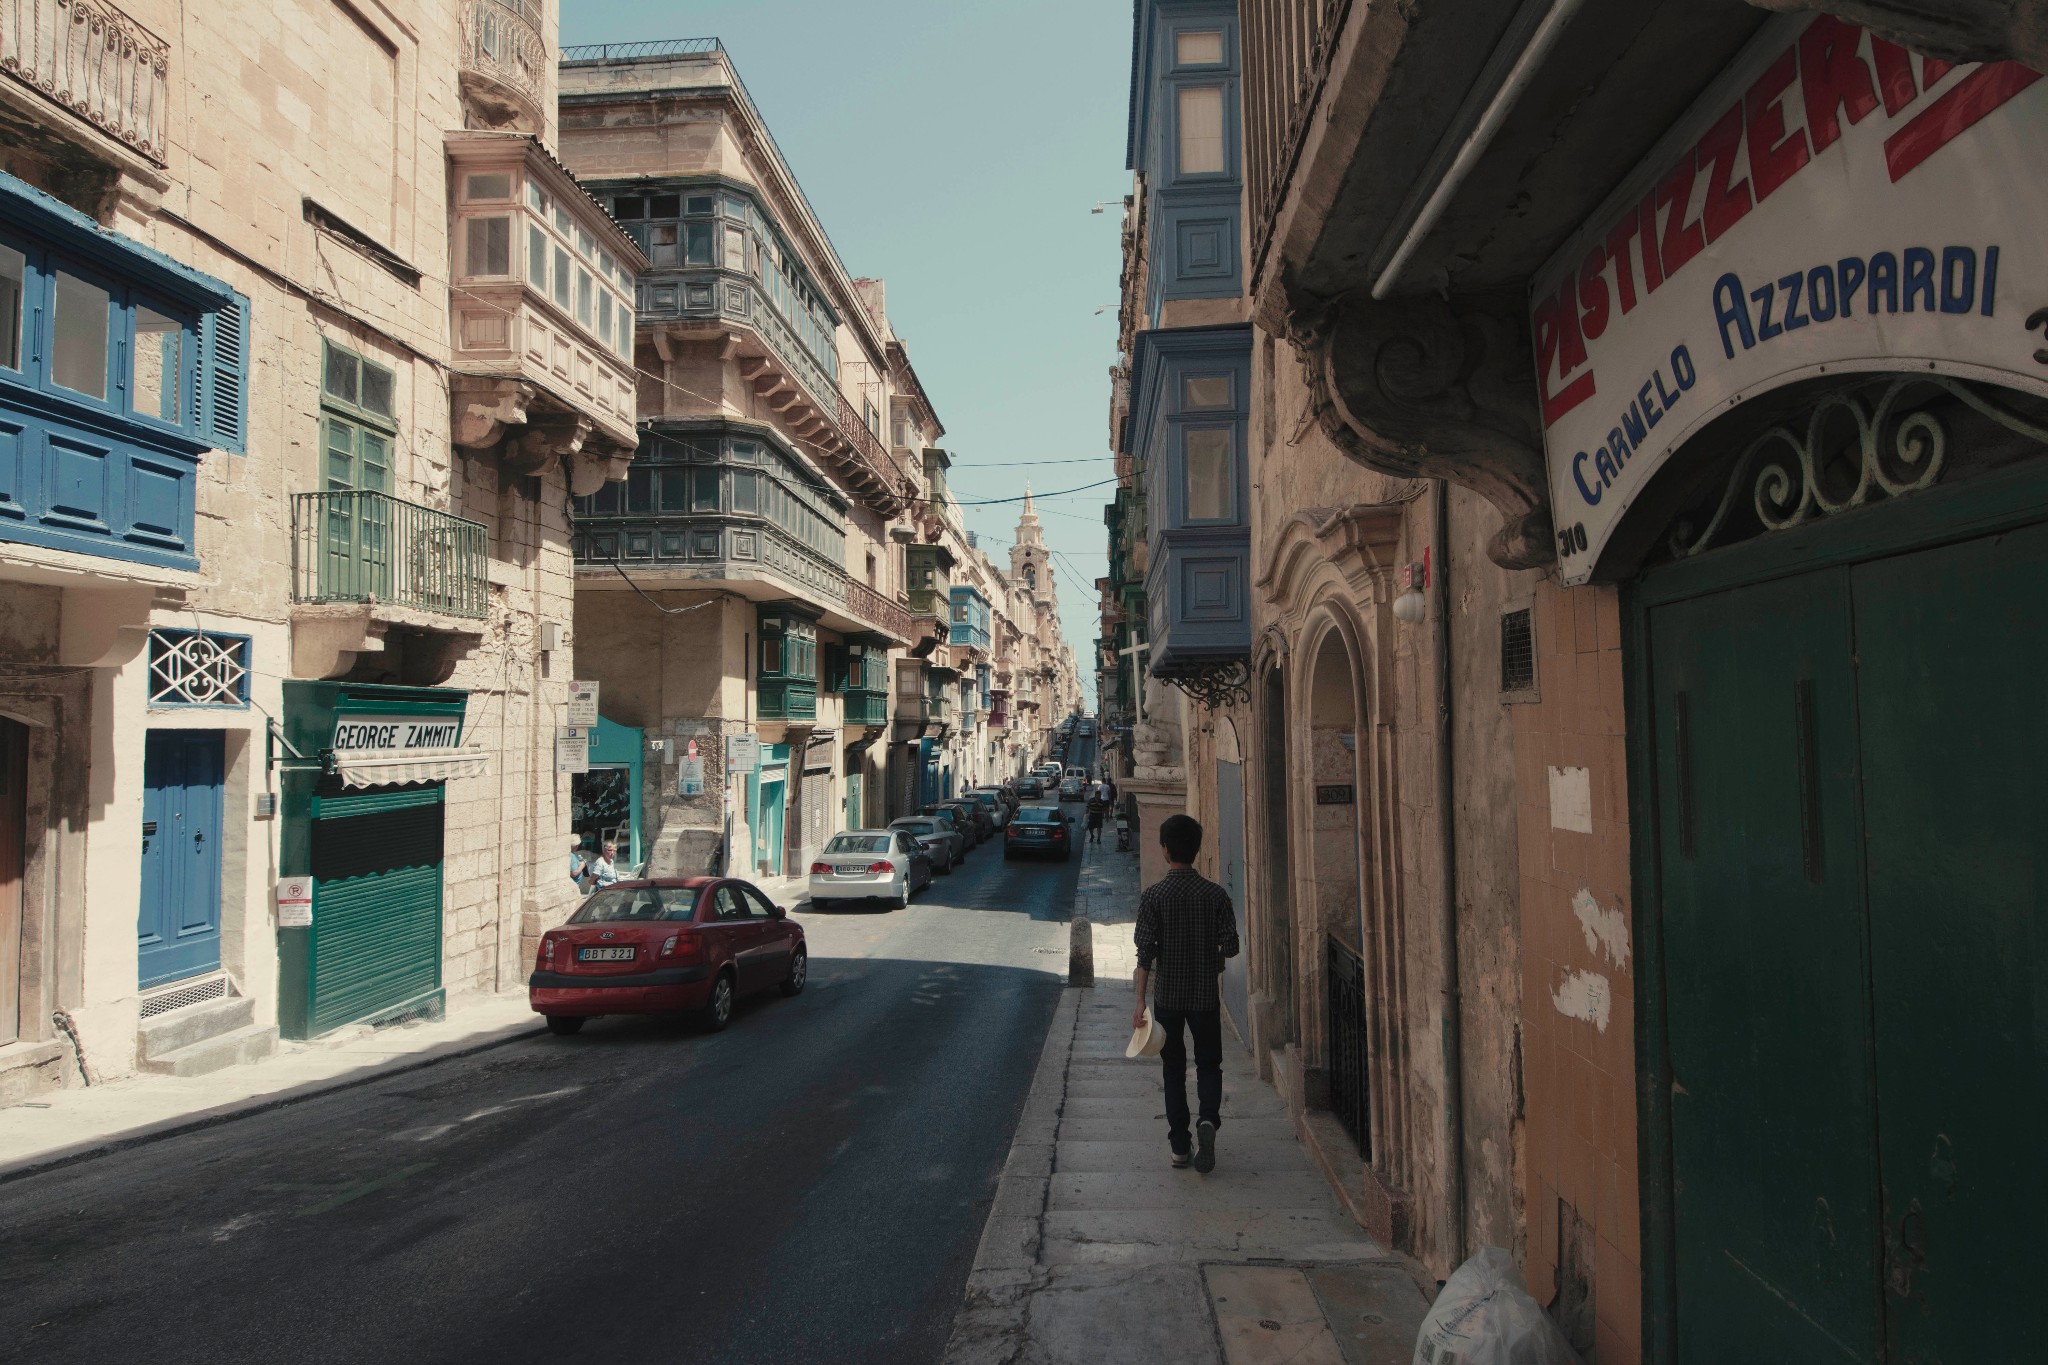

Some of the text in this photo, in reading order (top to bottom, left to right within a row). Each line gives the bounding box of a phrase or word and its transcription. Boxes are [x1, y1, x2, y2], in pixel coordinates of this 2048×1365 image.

[1571, 344, 1697, 506] CARMELO
[1558, 521, 1588, 558] 310
[335, 725, 456, 749] GEORGE ZAMMIT
[584, 948, 632, 960] BBT 321
